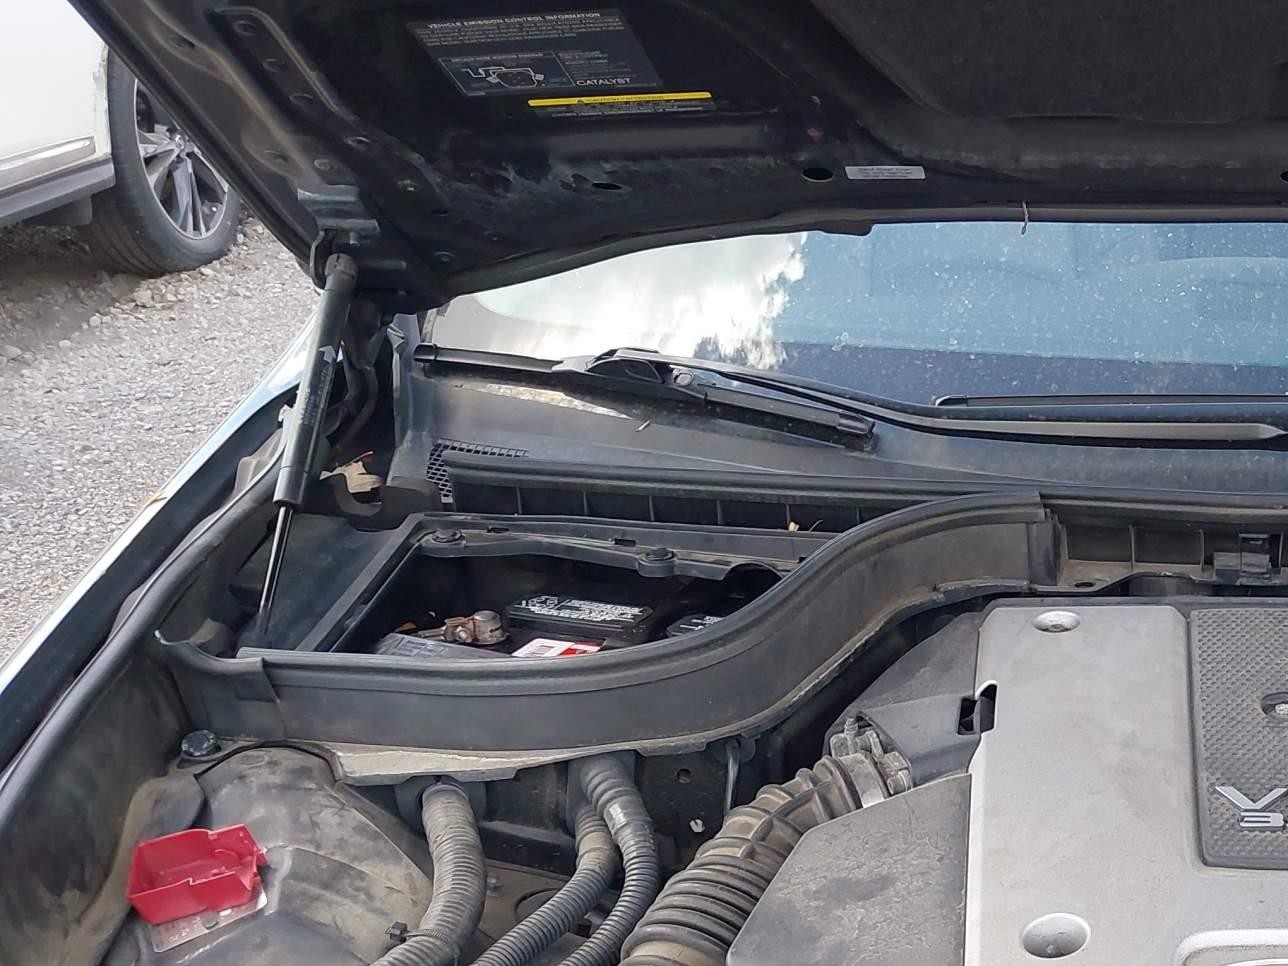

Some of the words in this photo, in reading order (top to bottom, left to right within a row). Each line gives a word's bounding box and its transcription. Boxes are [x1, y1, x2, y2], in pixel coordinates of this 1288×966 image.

[427, 20, 462, 30] VEHICLE
[464, 17, 504, 27] EMISSION
[505, 14, 544, 24] CONTROL
[545, 12, 602, 22] INFORMATION
[576, 77, 631, 87] CATALYST
